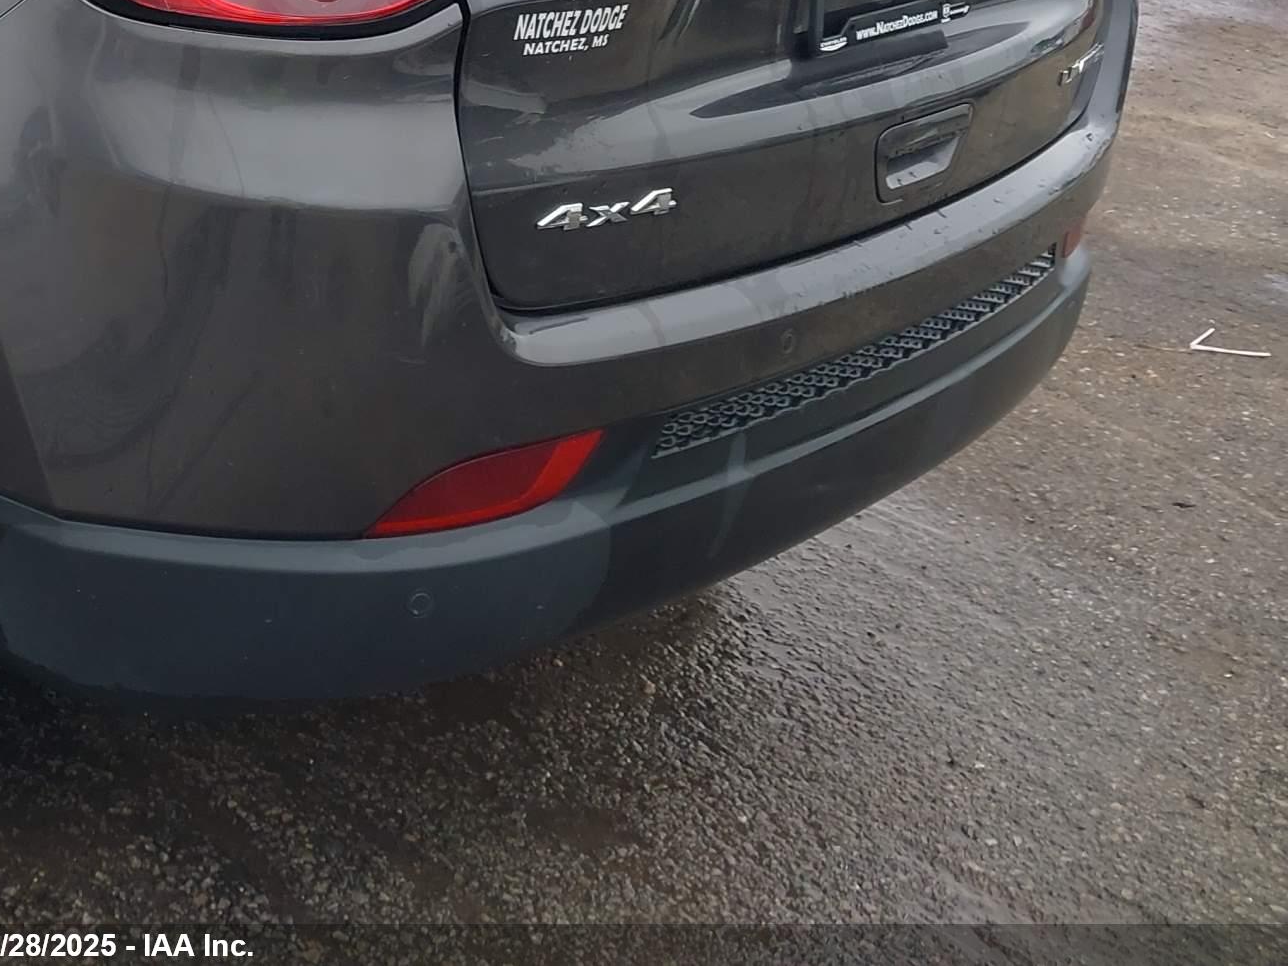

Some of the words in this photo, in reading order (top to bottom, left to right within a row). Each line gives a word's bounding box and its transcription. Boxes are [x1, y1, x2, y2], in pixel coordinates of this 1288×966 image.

[513, 10, 582, 41] NATCHEZ
[579, 4, 629, 35] DODGE
[523, 37, 590, 56] NATCHEZ,
[592, 34, 610, 48] MS
[536, 188, 678, 231] 4x4
